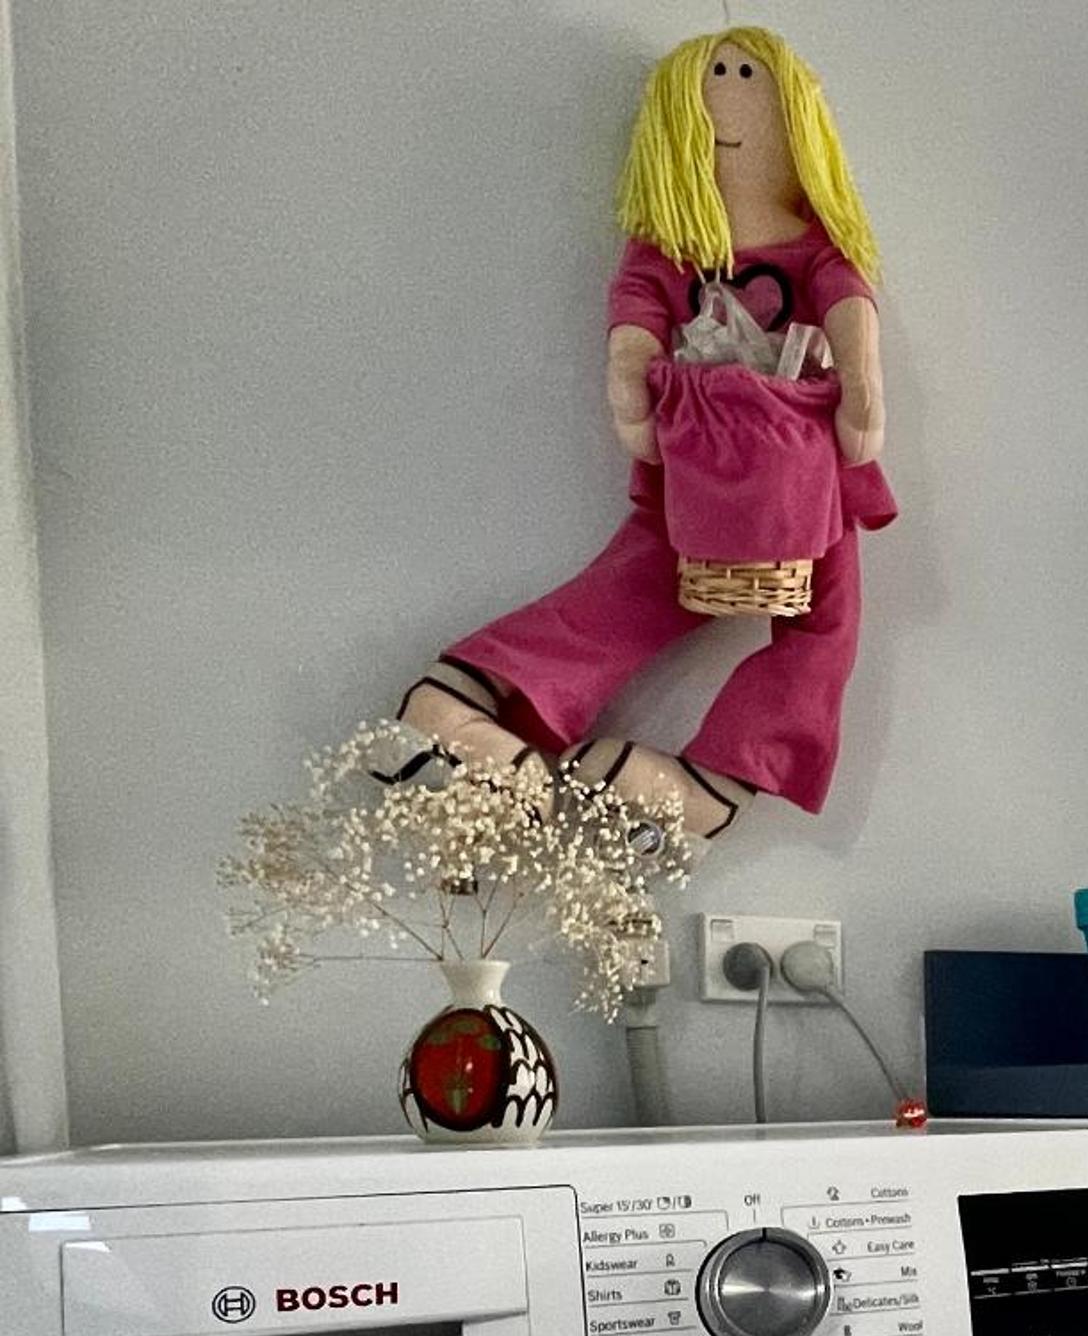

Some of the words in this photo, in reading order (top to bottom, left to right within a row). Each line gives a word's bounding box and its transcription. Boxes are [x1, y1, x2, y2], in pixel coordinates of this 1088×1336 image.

[743, 1192, 761, 1207] Off
[870, 1187, 909, 1199] Cottons
[580, 1200, 613, 1215] Super
[583, 1230, 621, 1244] Allergy
[624, 1228, 649, 1241] Plus
[866, 1240, 891, 1255] Easy
[892, 1239, 915, 1251] Care
[585, 1259, 637, 1272] Kidswear
[275, 1282, 399, 1312] BOSCH
[587, 1289, 622, 1302] Shirts
[589, 1317, 656, 1333] Sportswear
[898, 1319, 924, 1332] Wool
